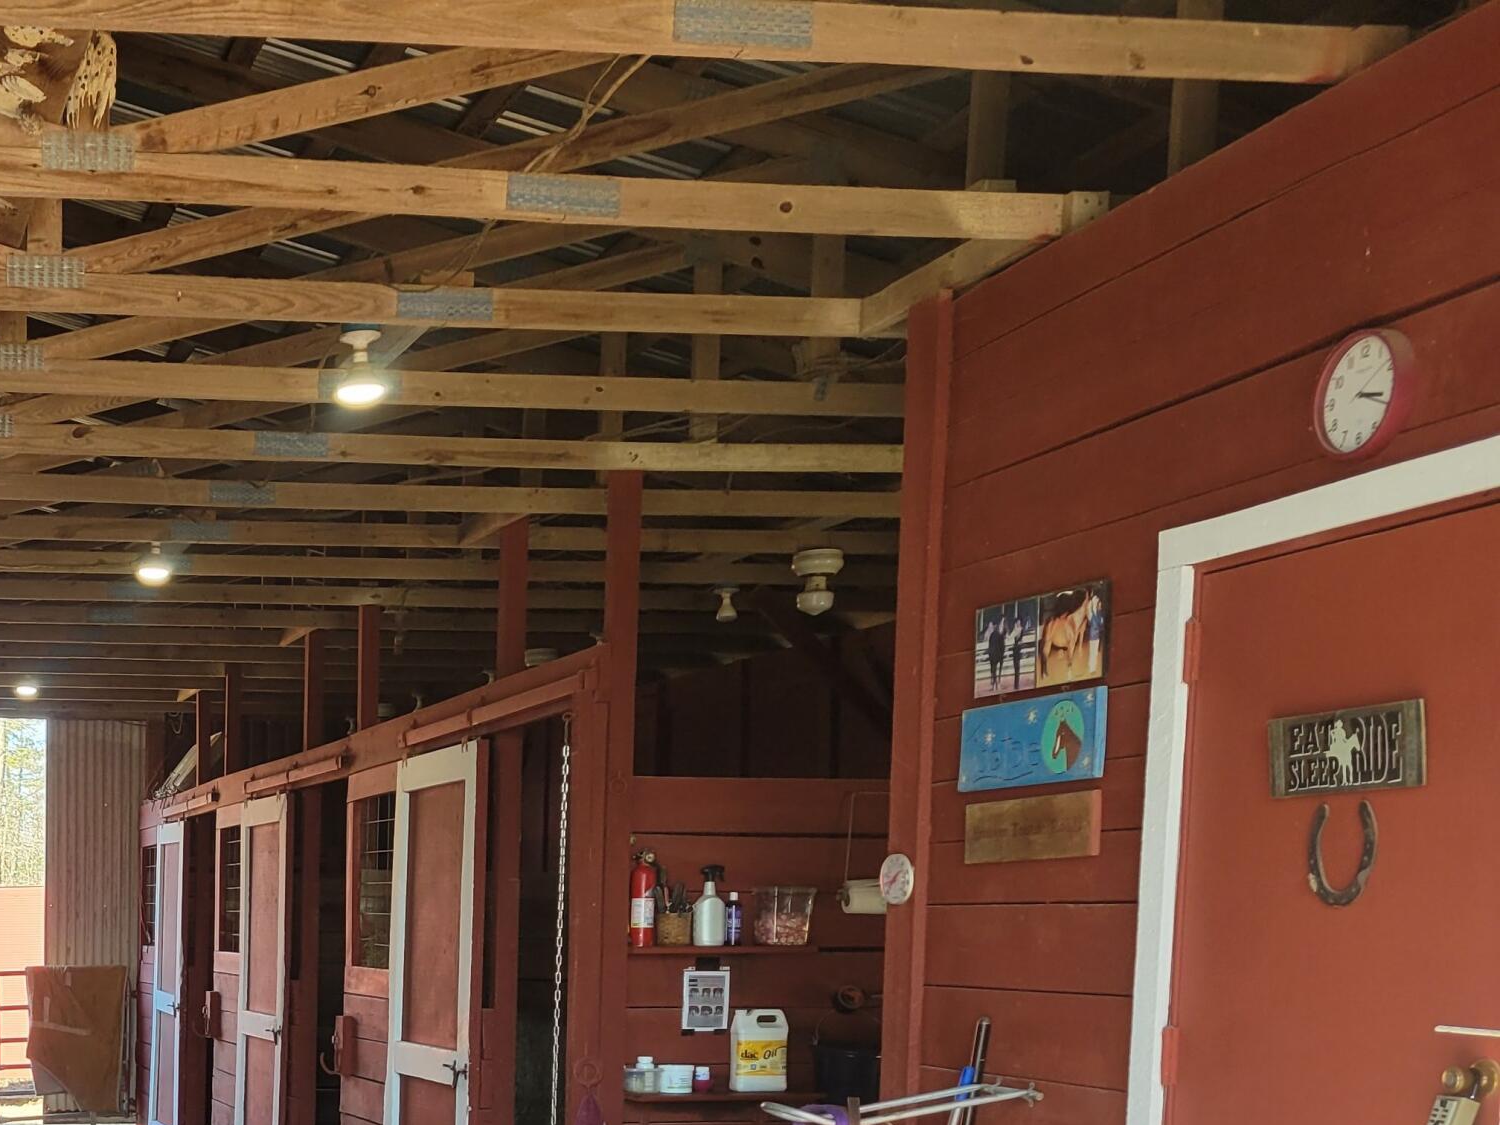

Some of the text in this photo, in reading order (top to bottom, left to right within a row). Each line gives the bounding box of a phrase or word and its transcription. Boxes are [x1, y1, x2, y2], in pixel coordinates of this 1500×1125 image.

[1339, 429, 1349, 449] 7
[1289, 719, 1334, 758] EAT
[1350, 711, 1402, 786] RIDE
[1288, 756, 1341, 792] SLEEP
